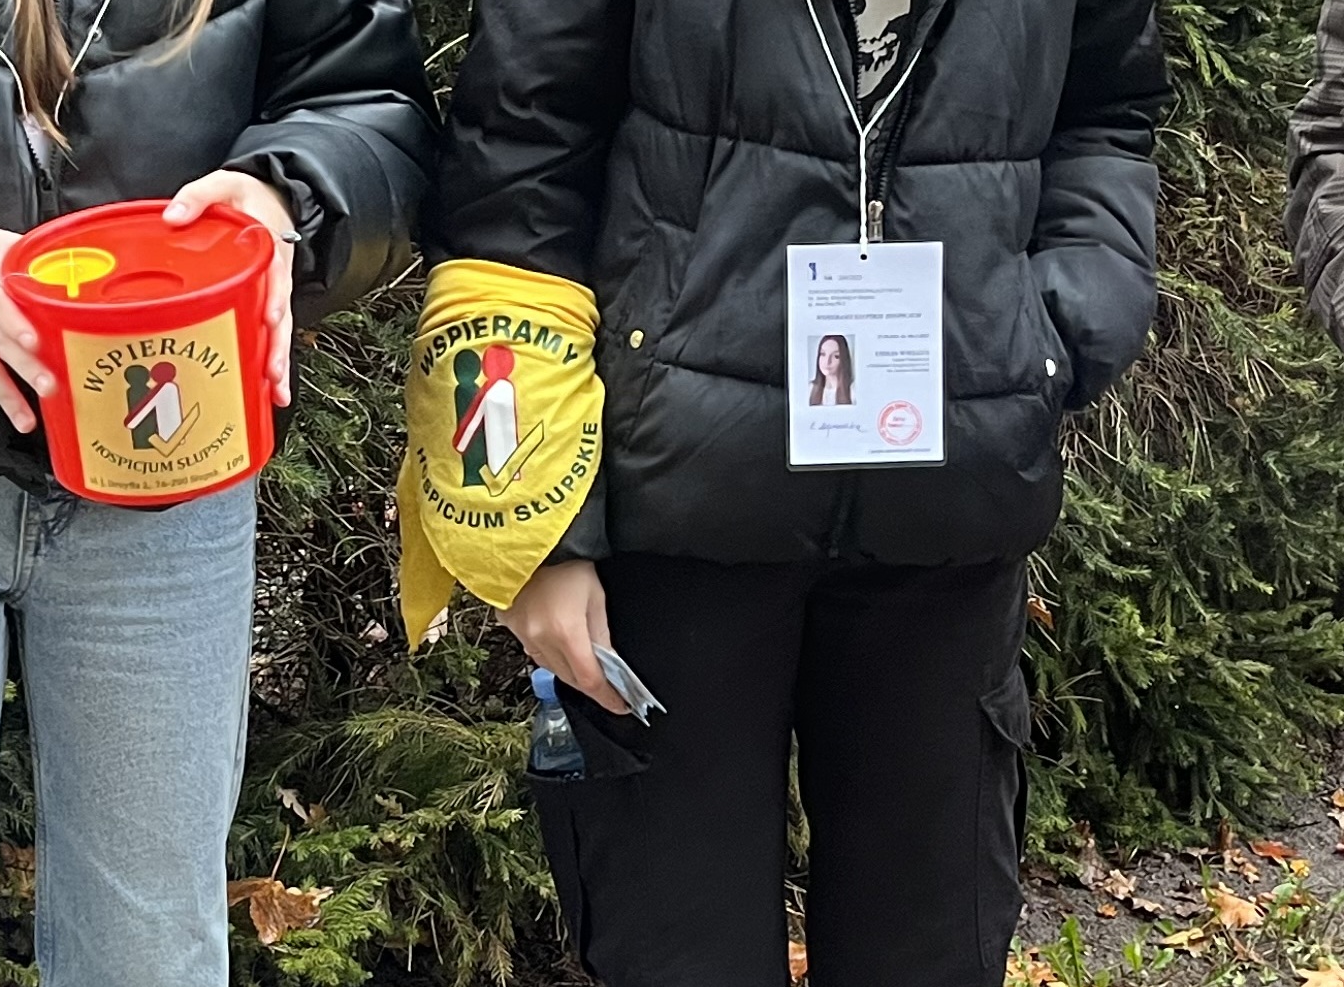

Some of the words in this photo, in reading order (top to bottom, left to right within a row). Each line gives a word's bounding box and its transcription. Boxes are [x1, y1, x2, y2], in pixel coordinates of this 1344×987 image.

[83, 337, 229, 393] WSPIERAMY
[419, 314, 579, 377] WSPIERAMY
[91, 439, 174, 475] HOSPICJUM
[416, 447, 505, 529] HOSPICJUM
[513, 422, 598, 522] SŁUPSKIE
